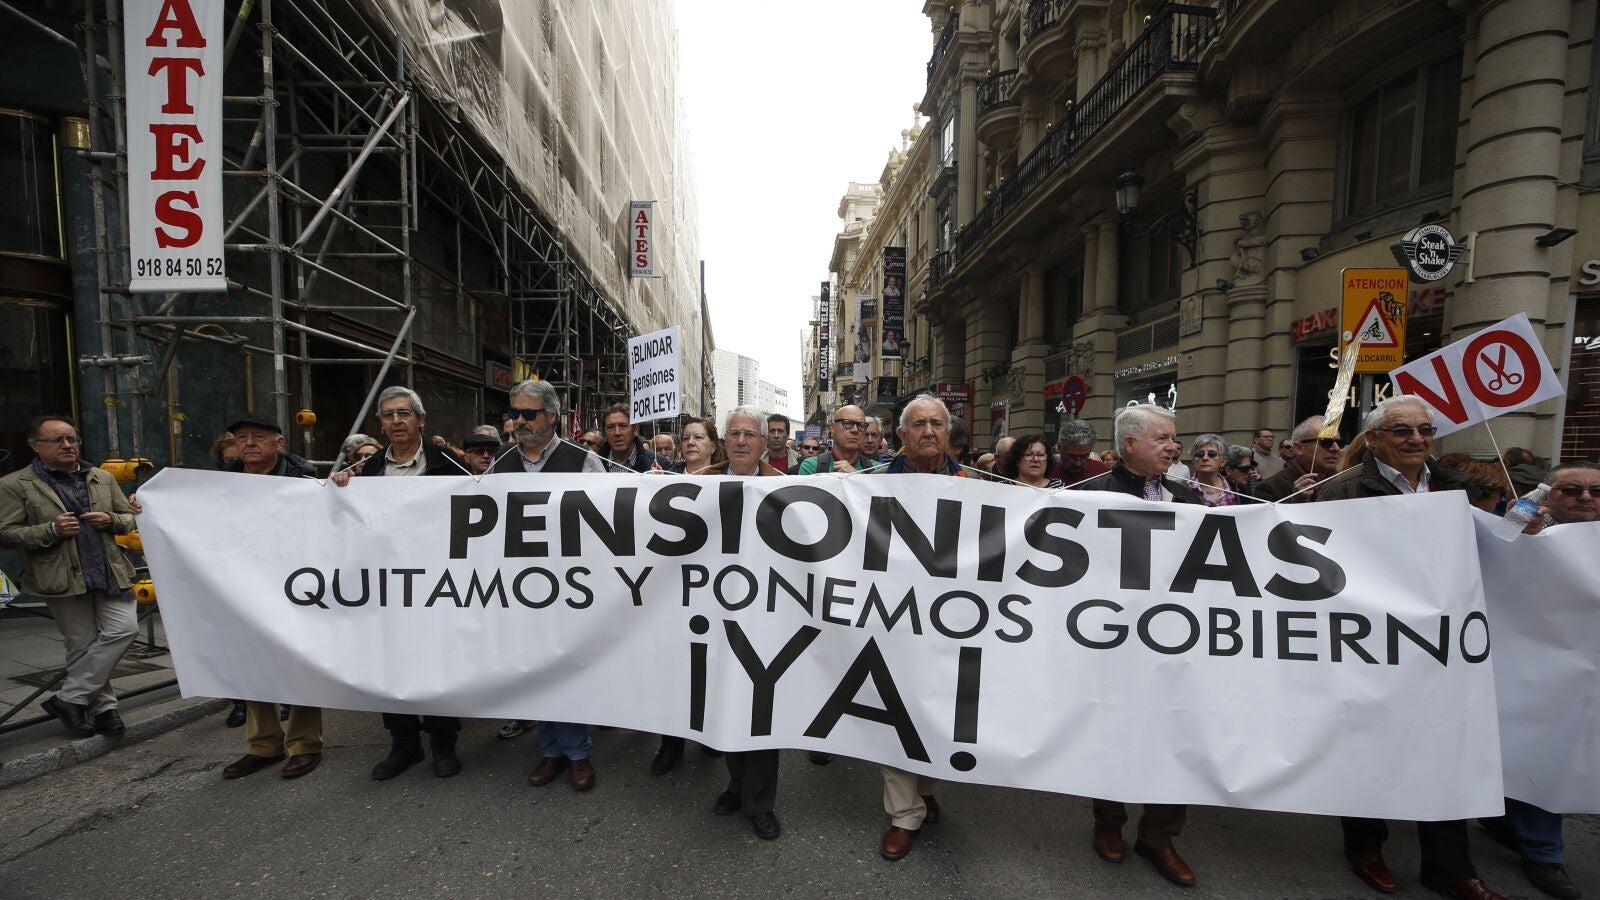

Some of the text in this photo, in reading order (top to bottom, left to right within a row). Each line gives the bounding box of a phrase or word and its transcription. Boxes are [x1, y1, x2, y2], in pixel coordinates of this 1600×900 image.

[145, 0, 207, 249] ATES
[634, 209, 649, 268] ATES
[1420, 237, 1445, 250] Steak
[137, 257, 223, 277] 918 84 50 52
[1419, 252, 1446, 266] Shake
[1348, 279, 1404, 290] ATENCION
[631, 335, 673, 370] ¡BLINDAR
[1356, 354, 1397, 363] CLOCARRIL
[633, 368, 675, 397] pensiones
[1396, 329, 1542, 425] NO
[633, 391, 676, 419] POR LEY!
[449, 481, 1347, 603] PENSIONISTAS
[284, 564, 1491, 668] QUITAMOS Y PONEMOS GOBIERNO
[689, 614, 984, 773] ¡YA!
